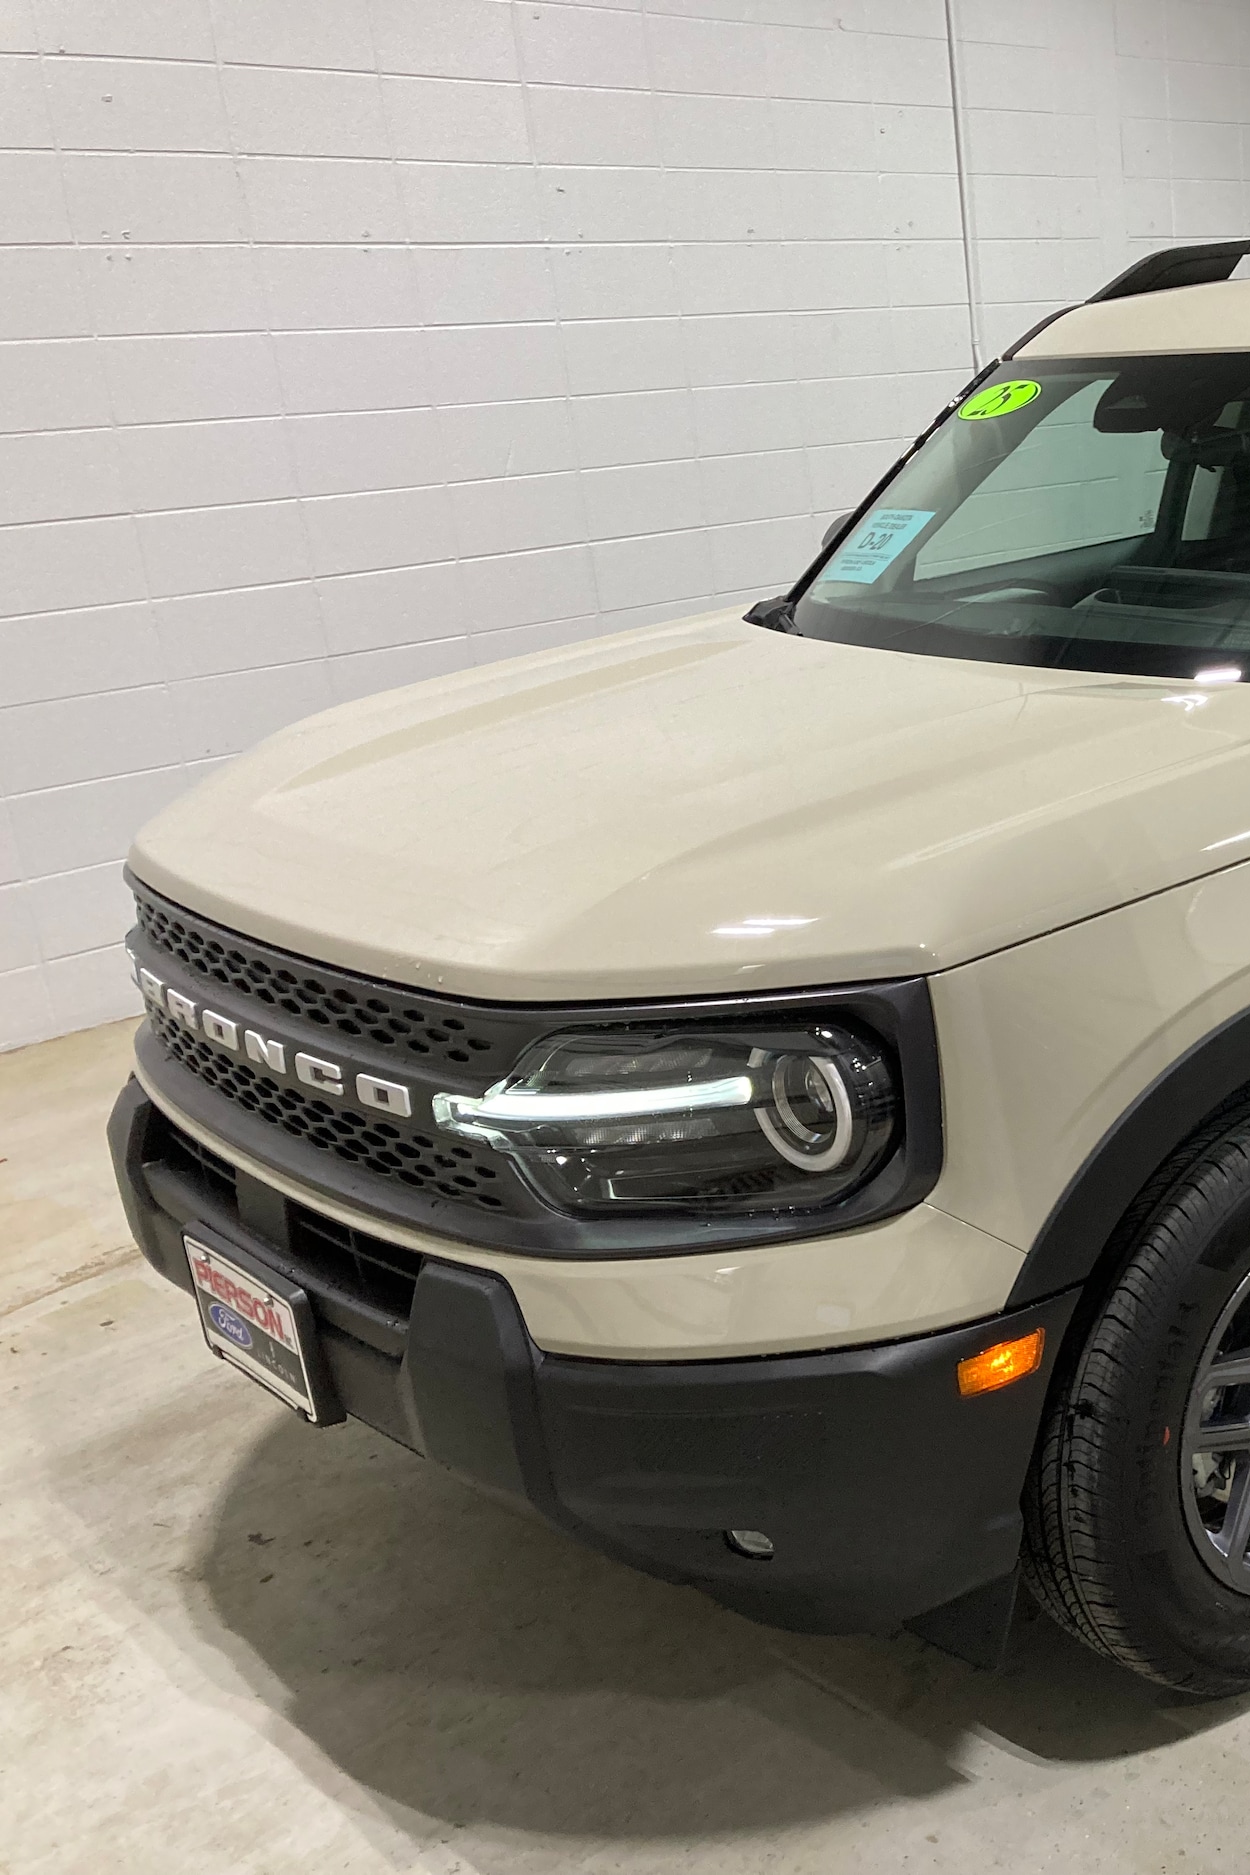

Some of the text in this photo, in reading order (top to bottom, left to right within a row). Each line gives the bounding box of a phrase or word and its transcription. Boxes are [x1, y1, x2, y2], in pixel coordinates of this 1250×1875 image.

[966, 383, 1031, 417] 25
[857, 531, 894, 551] D-20
[139, 967, 412, 1118] BRONCO
[193, 1257, 284, 1341] PIERSON
[217, 1307, 245, 1342] Ford
